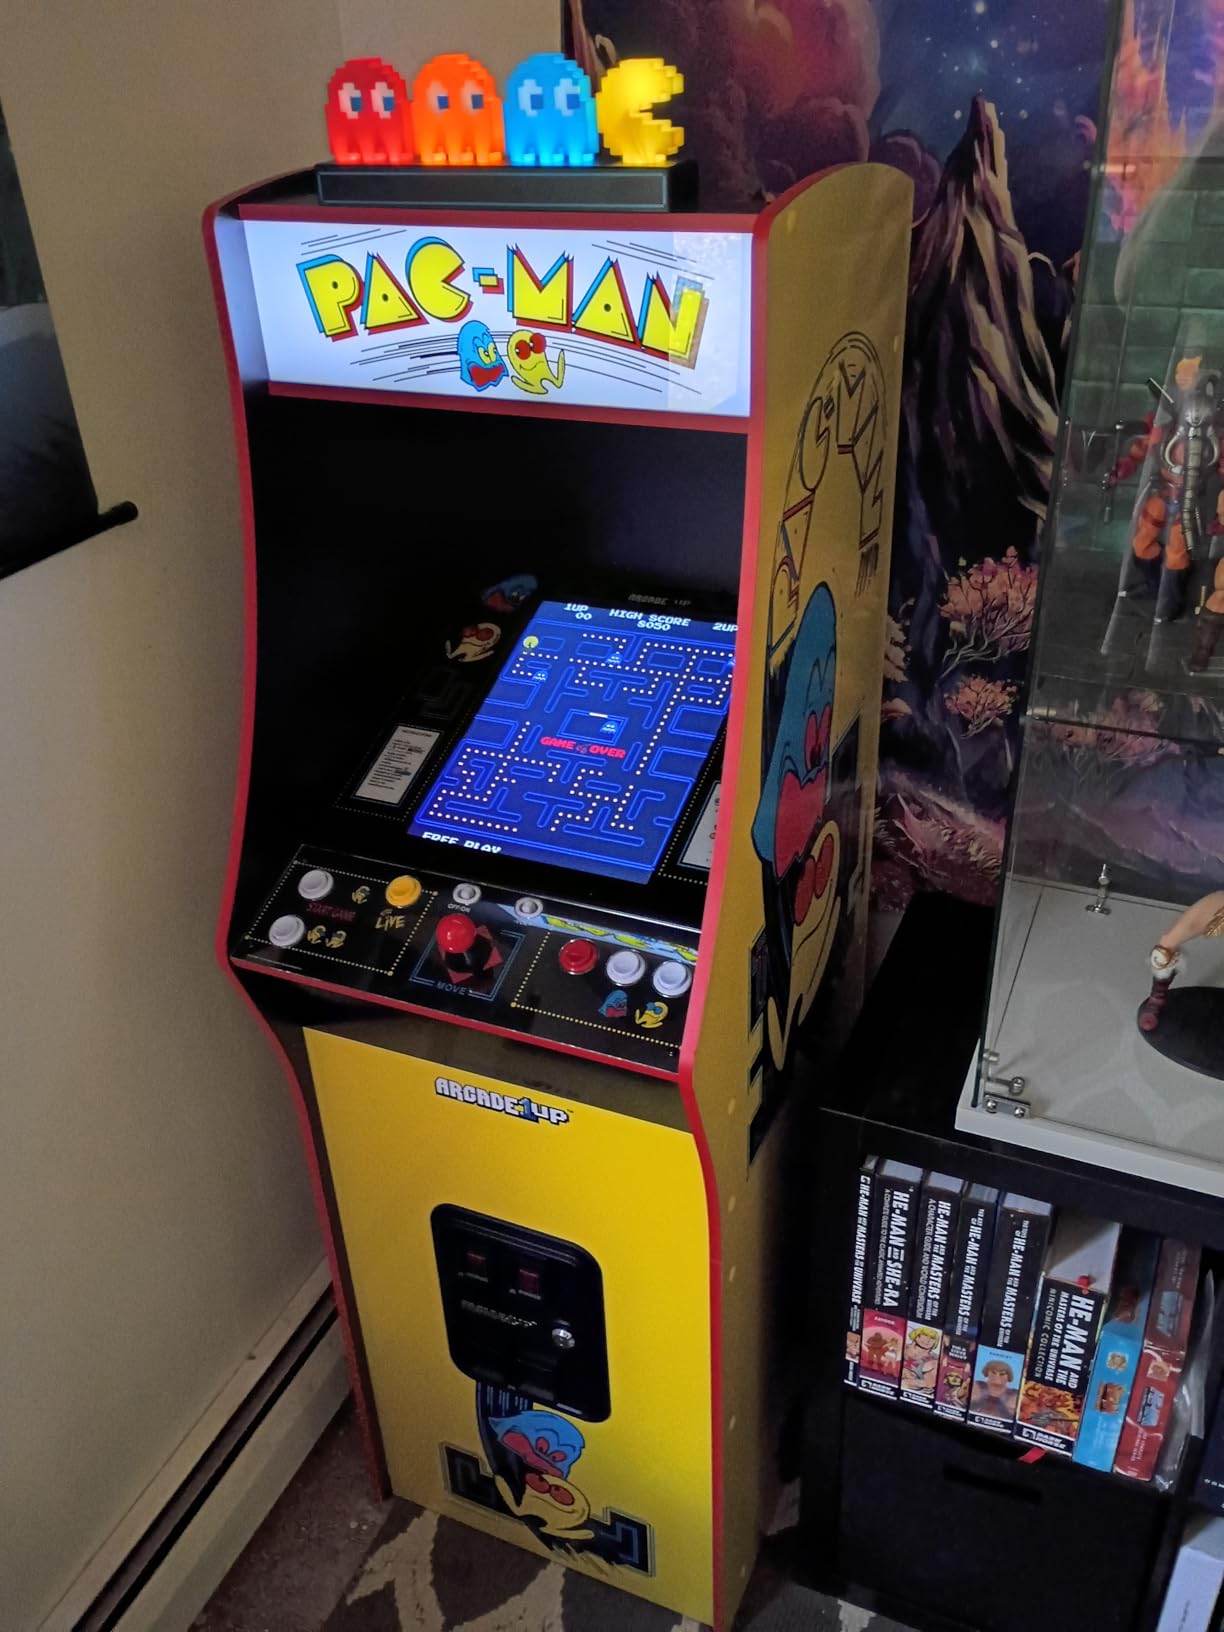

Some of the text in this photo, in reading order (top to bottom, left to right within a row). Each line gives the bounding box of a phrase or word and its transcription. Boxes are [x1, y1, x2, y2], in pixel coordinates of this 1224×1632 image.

[296, 236, 709, 370] PAC-MAN
[563, 603, 590, 612] 1UP
[575, 612, 592, 621] 00
[608, 609, 692, 627] HIGH SCORE
[712, 622, 739, 632] 2UP
[540, 736, 627, 759] GAME OVER
[437, 981, 467, 996] MOVE
[855, 1225, 867, 1260] MASTERS
[852, 1267, 863, 1304] UNIVERSE
[928, 1254, 944, 1299] MASTERS
[958, 1274, 975, 1316] MASTERS
[1000, 1286, 1018, 1328] MASTERS
[1035, 1288, 1056, 1378] MINICOMIC COLLECTION
[1044, 1291, 1069, 1381] MASTERS OF THE UNIVERSE
[1055, 1294, 1095, 1389] HE-MAN AND THE
